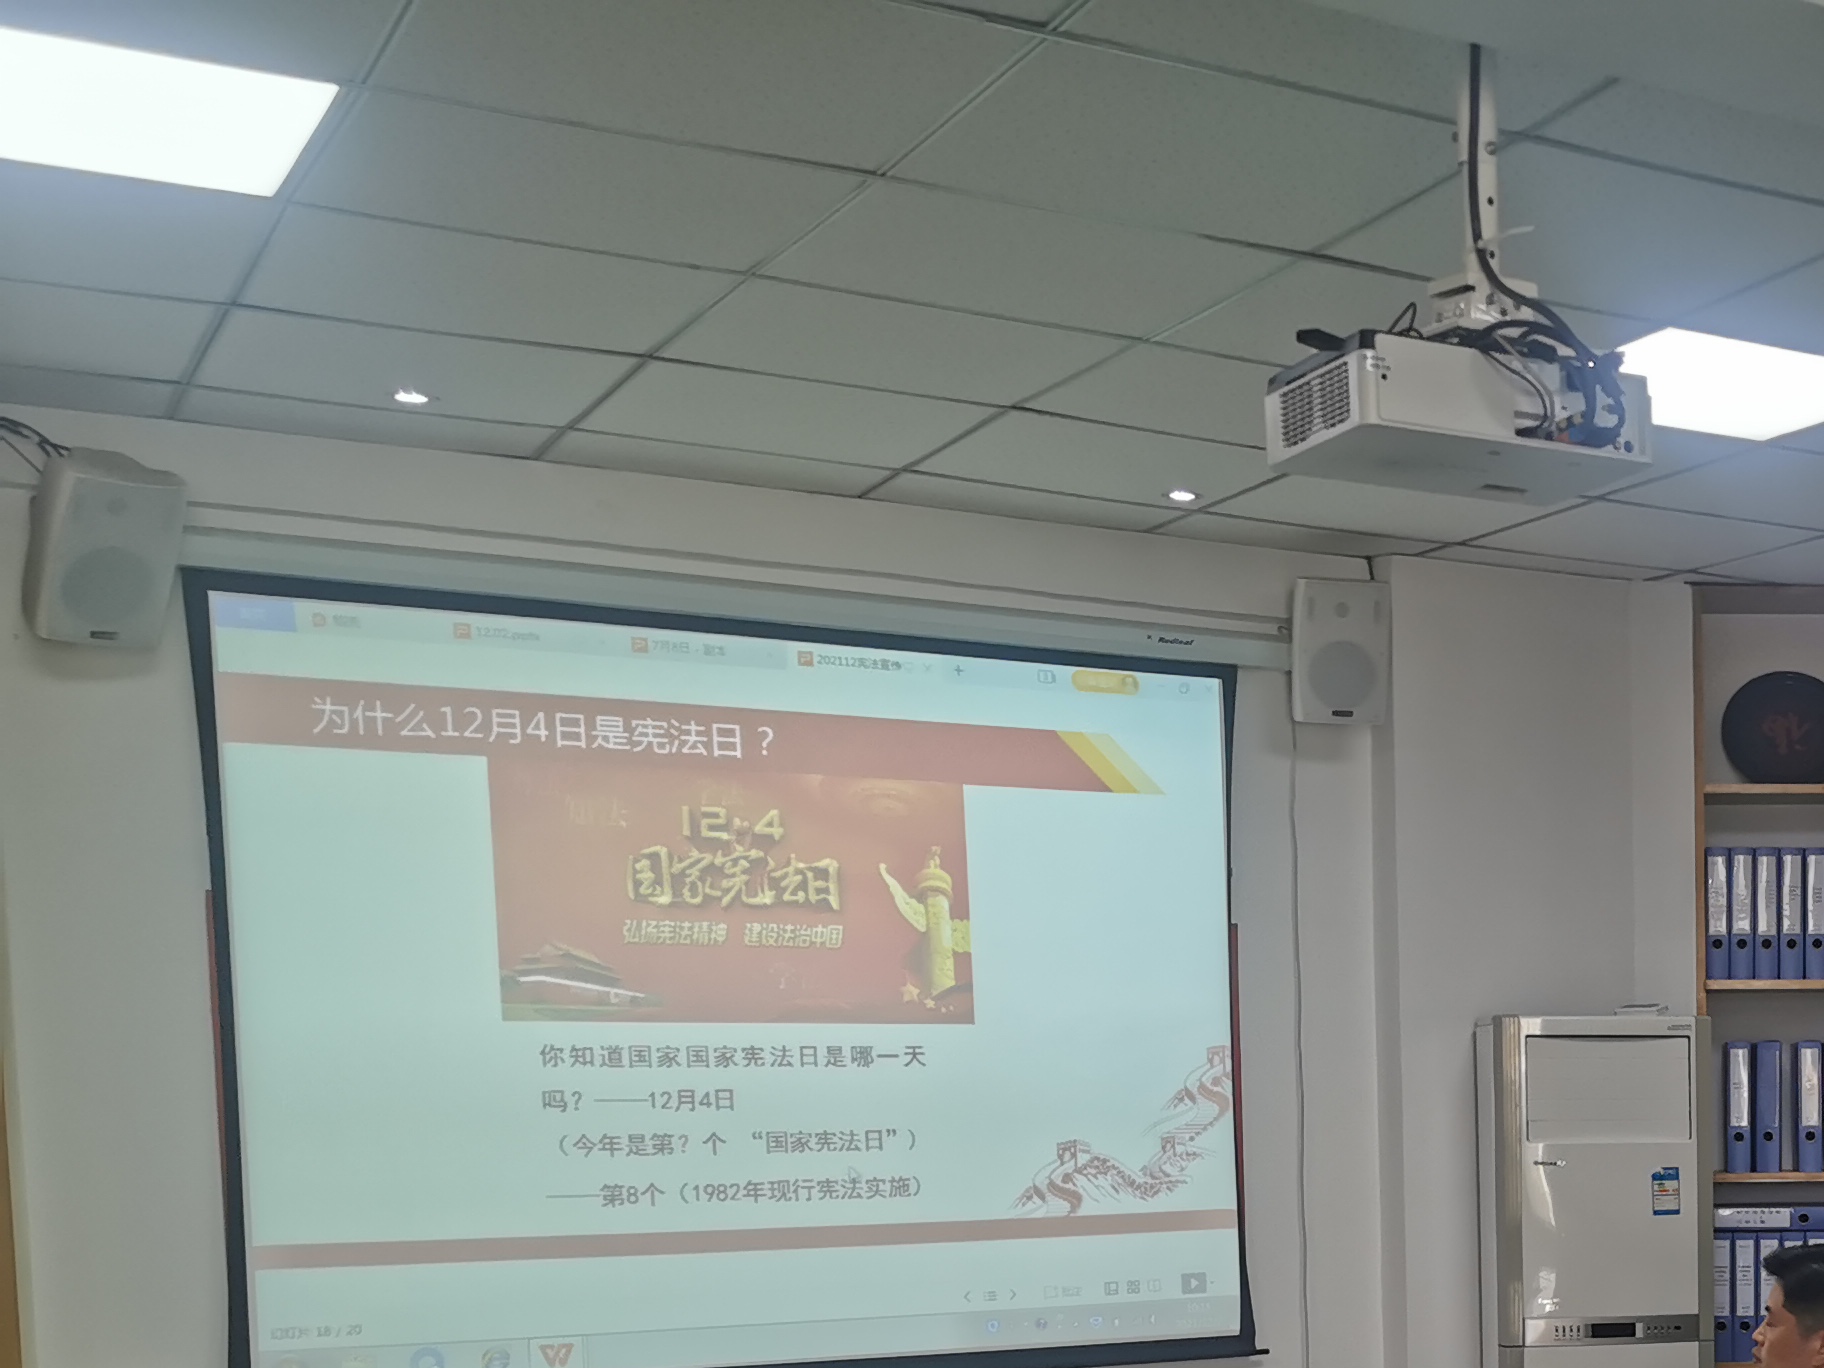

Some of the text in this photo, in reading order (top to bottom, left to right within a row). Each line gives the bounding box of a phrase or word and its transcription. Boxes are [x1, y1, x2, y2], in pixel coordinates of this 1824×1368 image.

[622, 919, 844, 950] 弘扬宪法精神 建设法治中国
[539, 1043, 928, 1070] 你知道国家国家宪法日是哪一天
